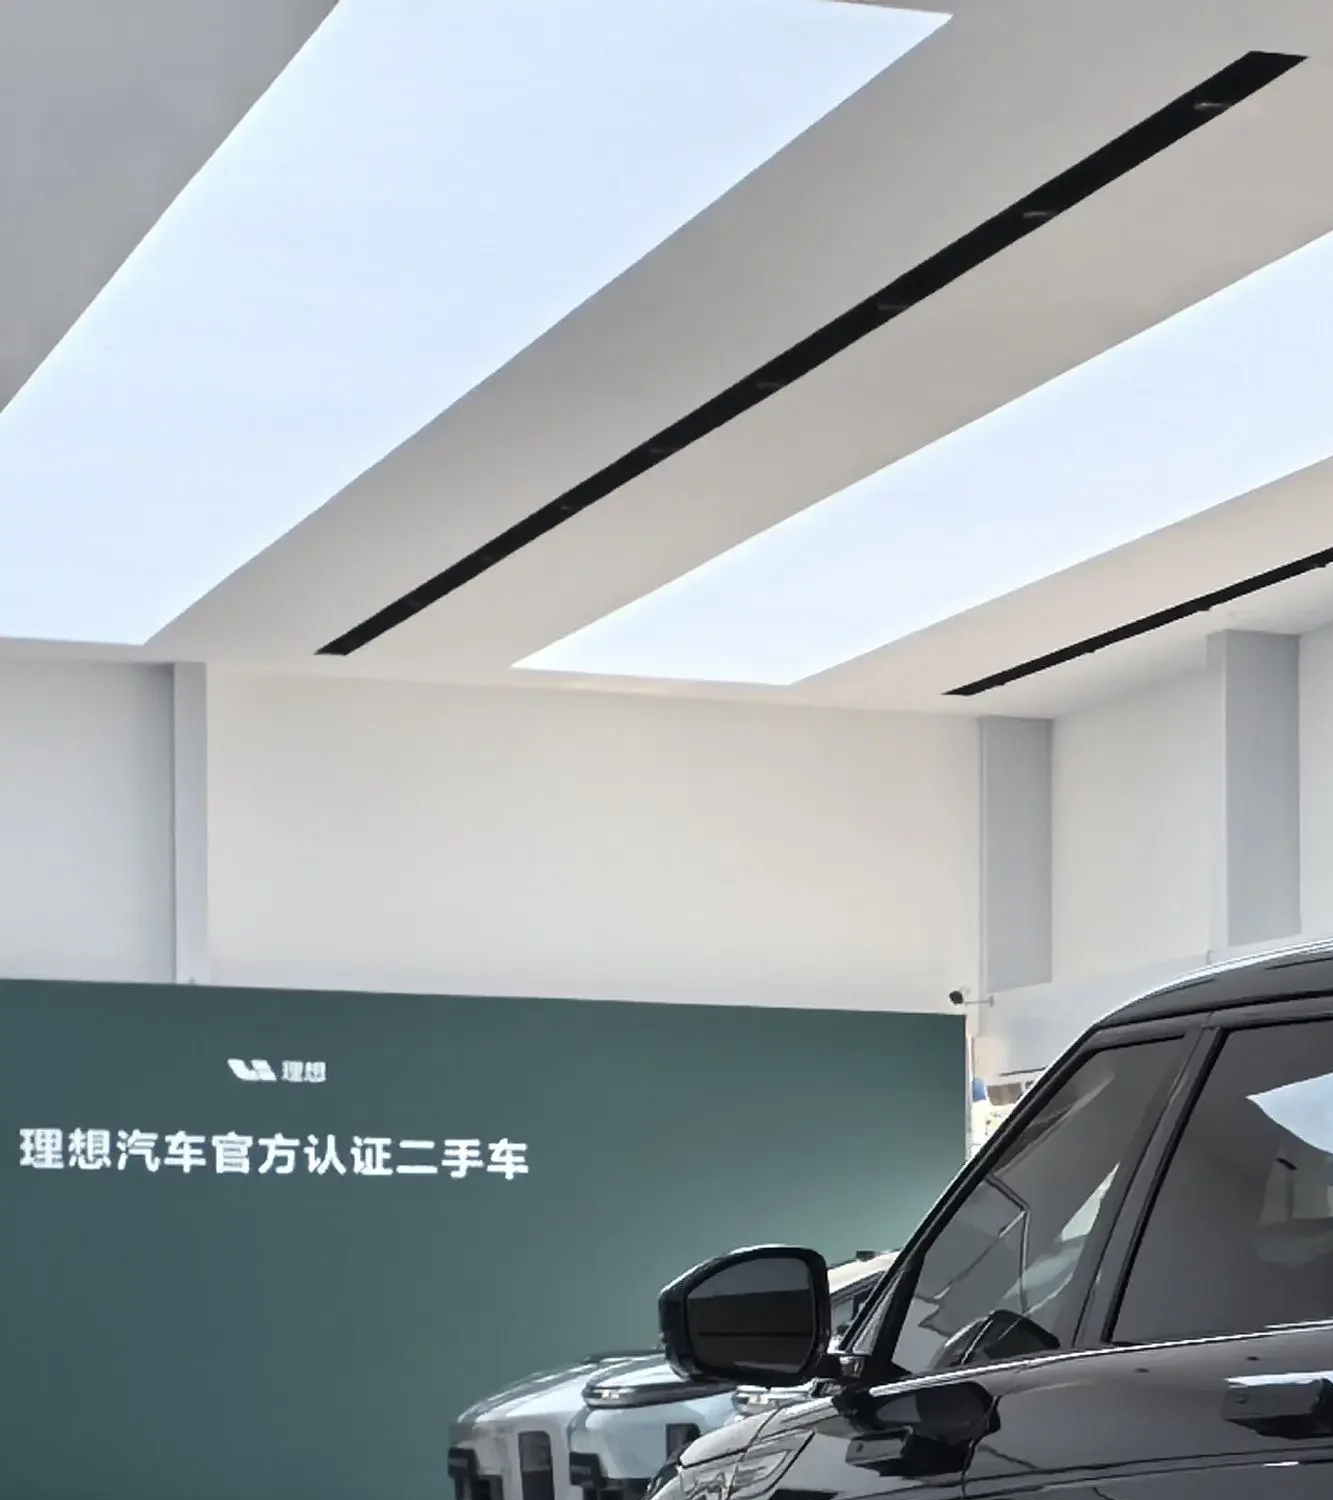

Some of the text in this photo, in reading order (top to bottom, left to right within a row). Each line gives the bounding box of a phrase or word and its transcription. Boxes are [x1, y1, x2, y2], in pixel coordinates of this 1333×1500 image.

[281, 1060, 327, 1083] 理想
[18, 1126, 530, 1180] 理想汽车官方认证二手车
